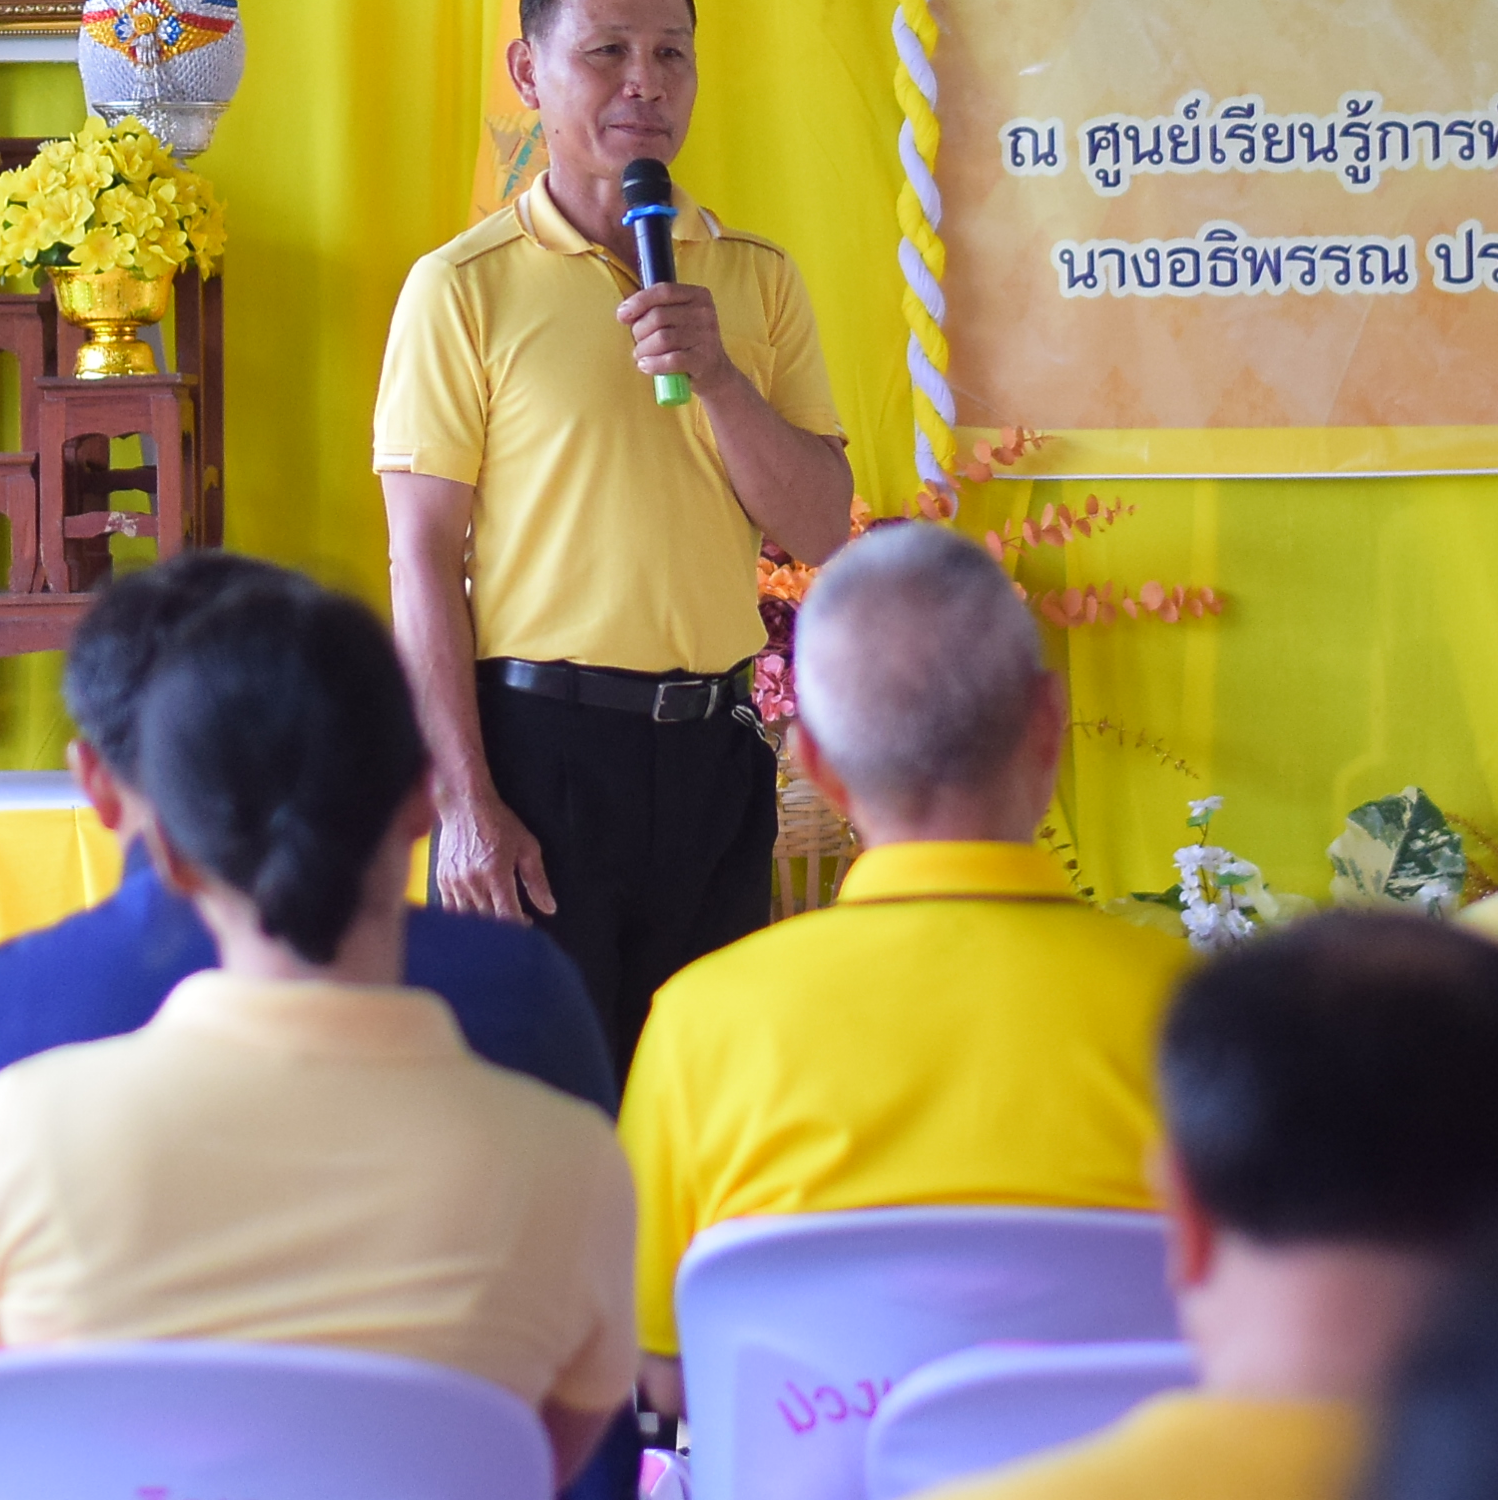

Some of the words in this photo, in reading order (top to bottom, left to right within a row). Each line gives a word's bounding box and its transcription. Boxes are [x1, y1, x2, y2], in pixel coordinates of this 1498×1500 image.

[1007, 126, 1058, 167] ณ
[1059, 228, 1409, 289] นางอธิพรรณ
